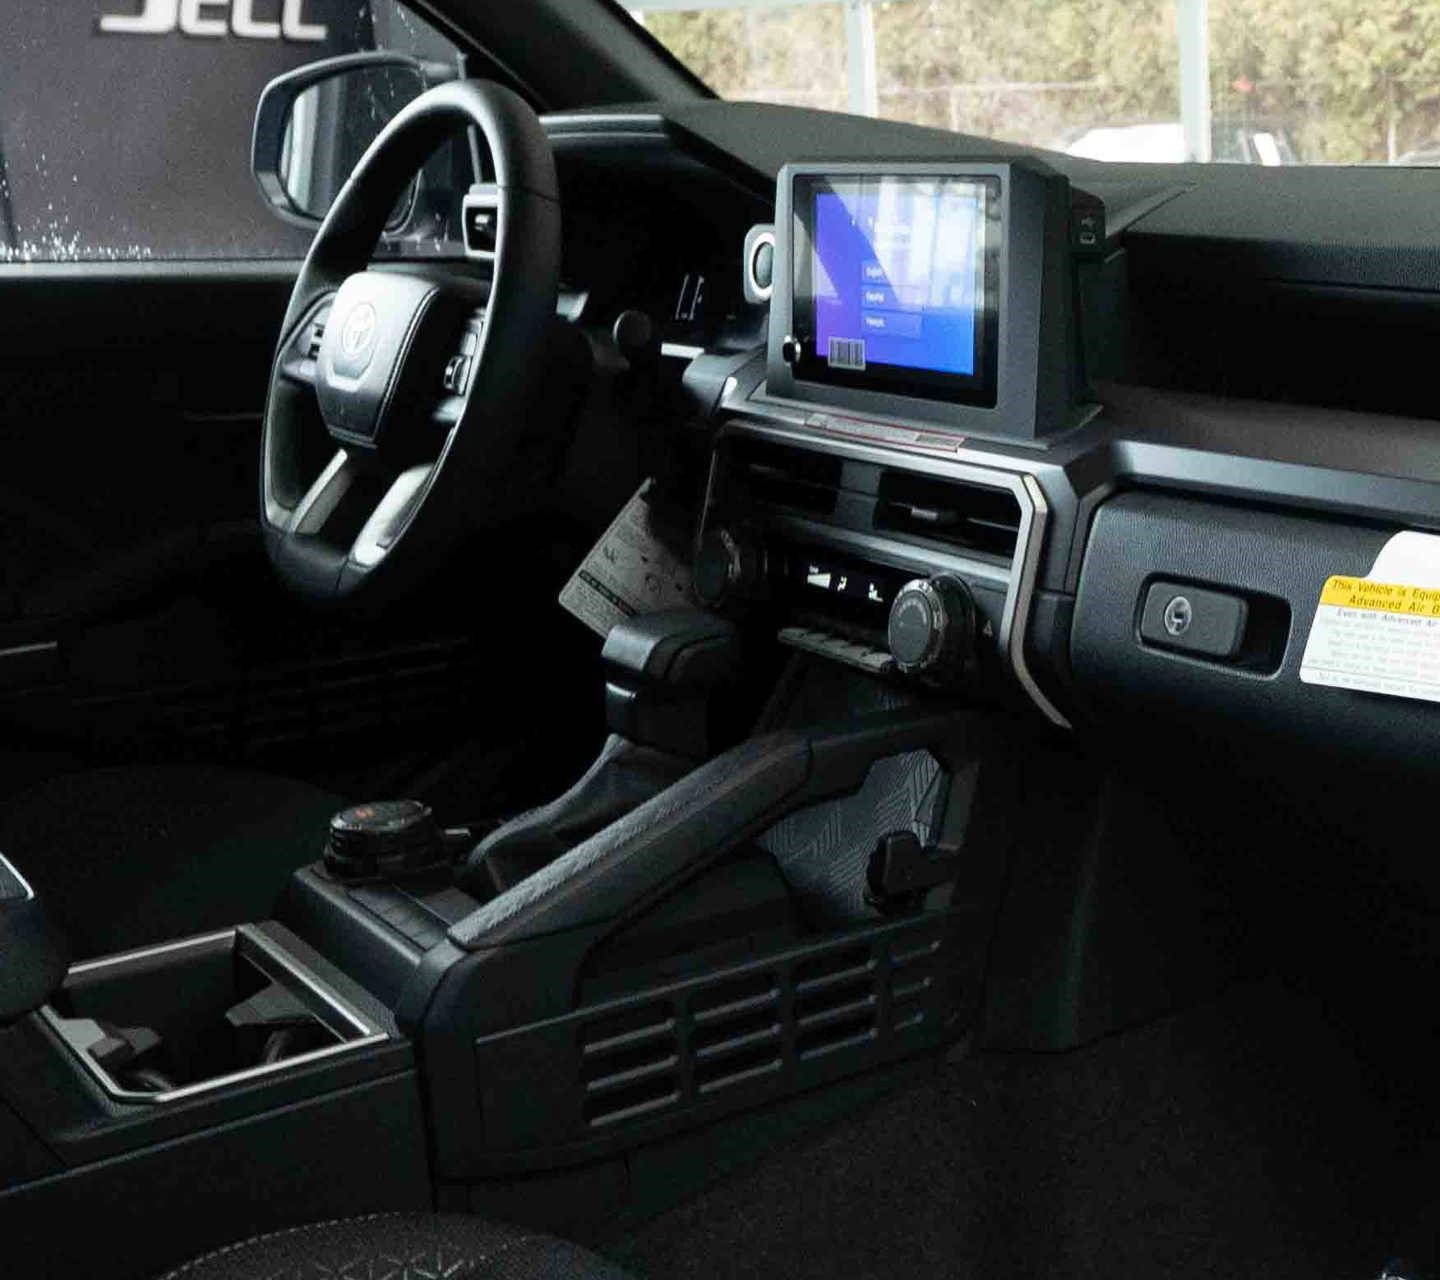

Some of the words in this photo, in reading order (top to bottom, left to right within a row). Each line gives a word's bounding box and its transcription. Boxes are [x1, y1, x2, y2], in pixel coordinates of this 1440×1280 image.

[1332, 580, 1353, 592] This
[1358, 581, 1393, 596] Vehicle
[1348, 596, 1402, 611] Advanced
[1408, 602, 1426, 613] Air
